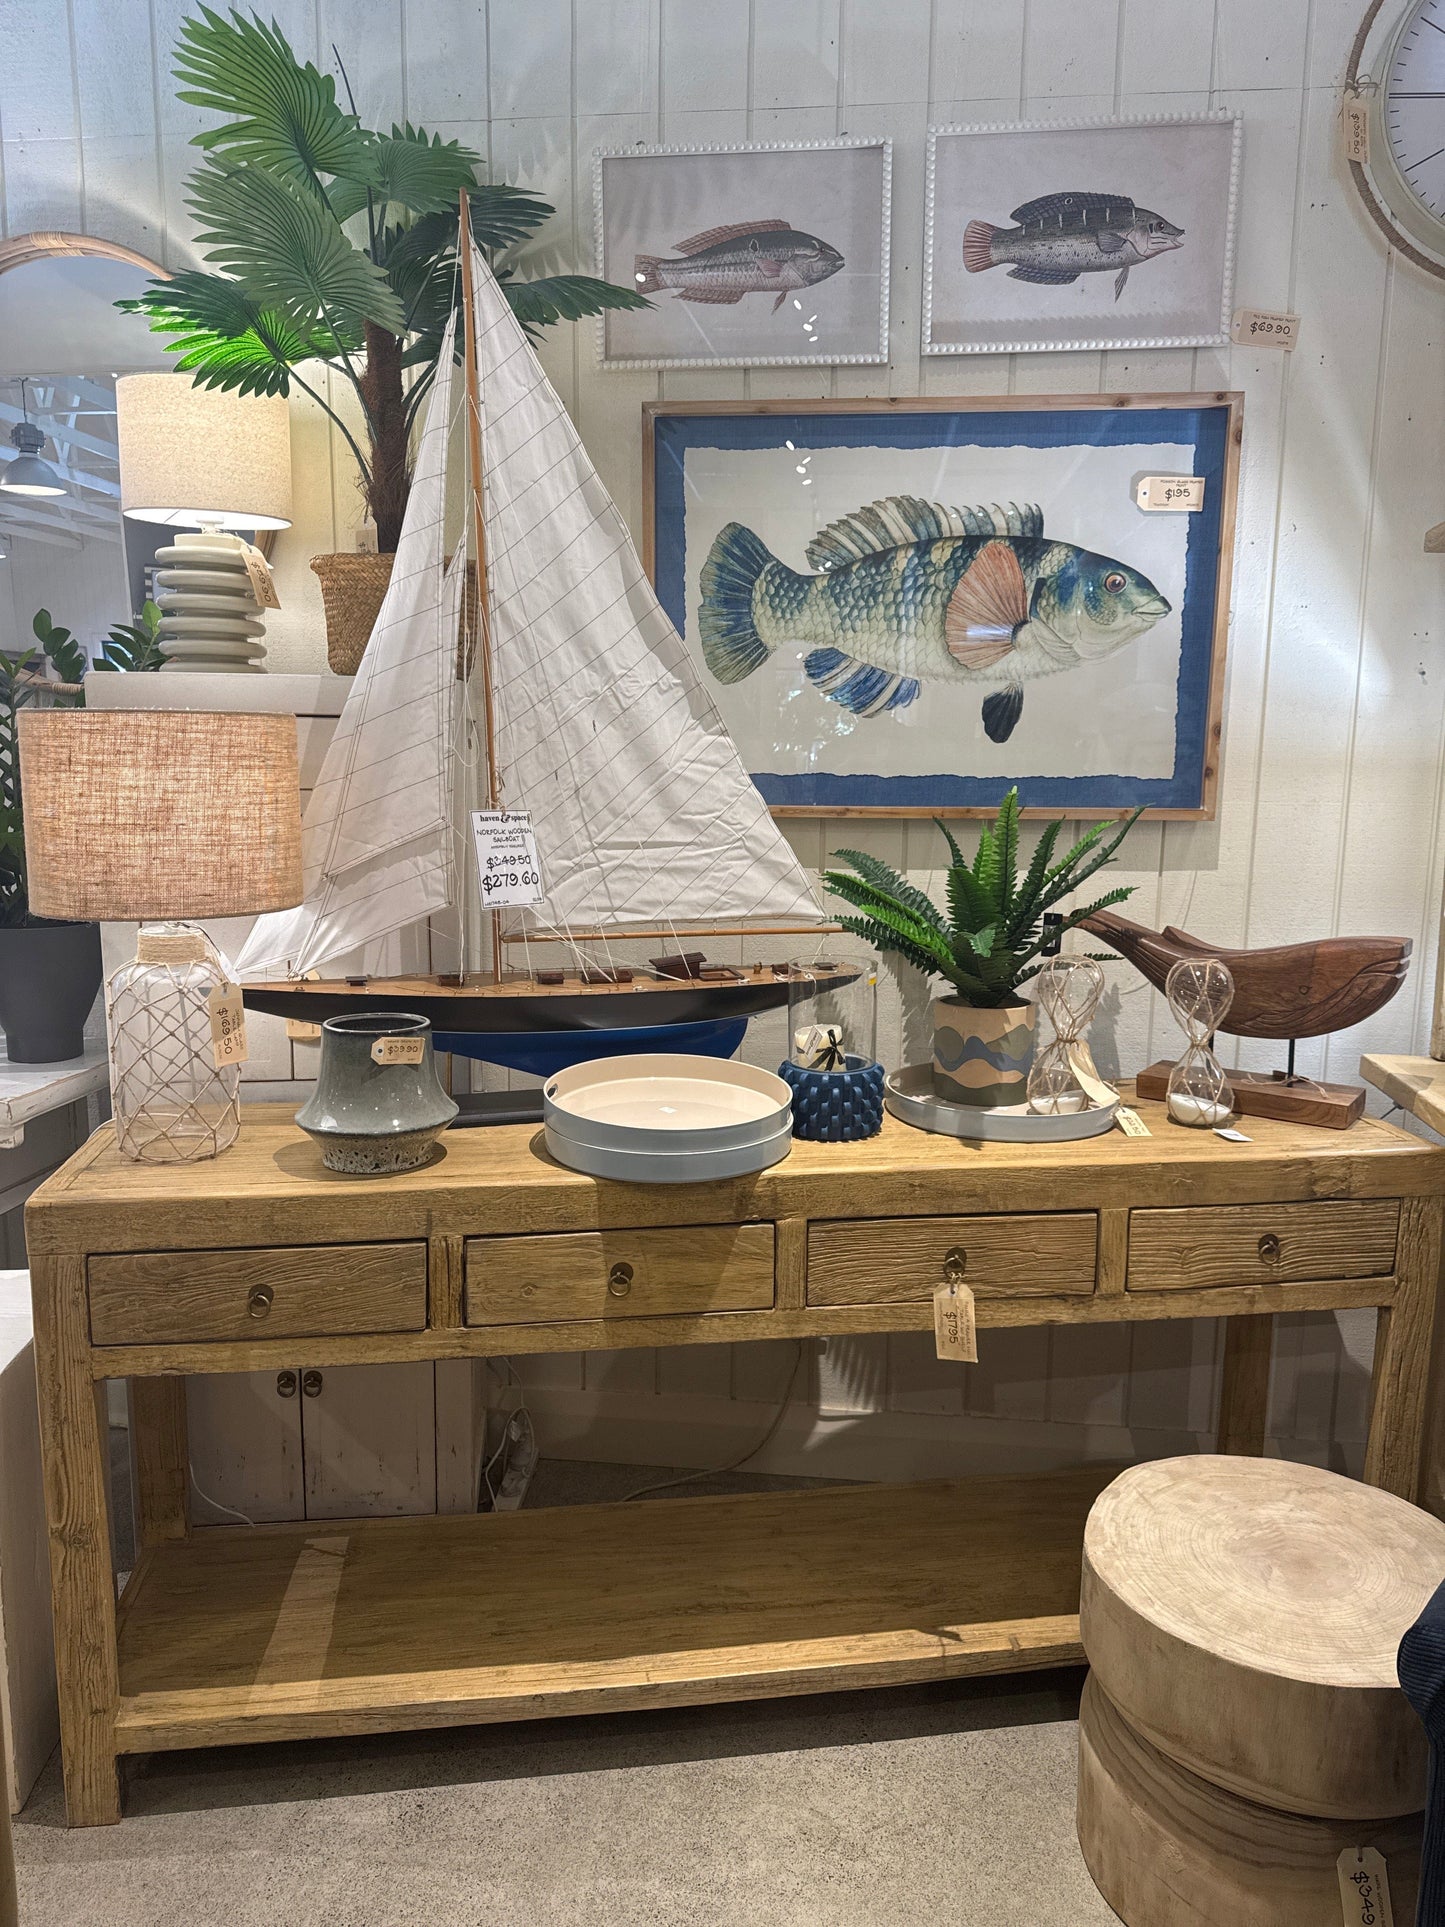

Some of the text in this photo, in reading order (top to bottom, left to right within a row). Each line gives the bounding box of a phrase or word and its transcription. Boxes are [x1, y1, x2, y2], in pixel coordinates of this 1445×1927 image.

[1250, 321, 1291, 336] $69.90
[1164, 488, 1191, 502] $195
[479, 814, 500, 822] haven
[510, 814, 527, 823] space
[476, 827, 532, 836] NORFOLK WOODEN
[492, 835, 520, 843] SAILBOAT
[486, 854, 531, 872] $349.50
[482, 870, 539, 896] $279.60
[216, 1007, 233, 1055] $169.50
[942, 1311, 959, 1344] $1795
[1349, 1870, 1376, 1926] $349
